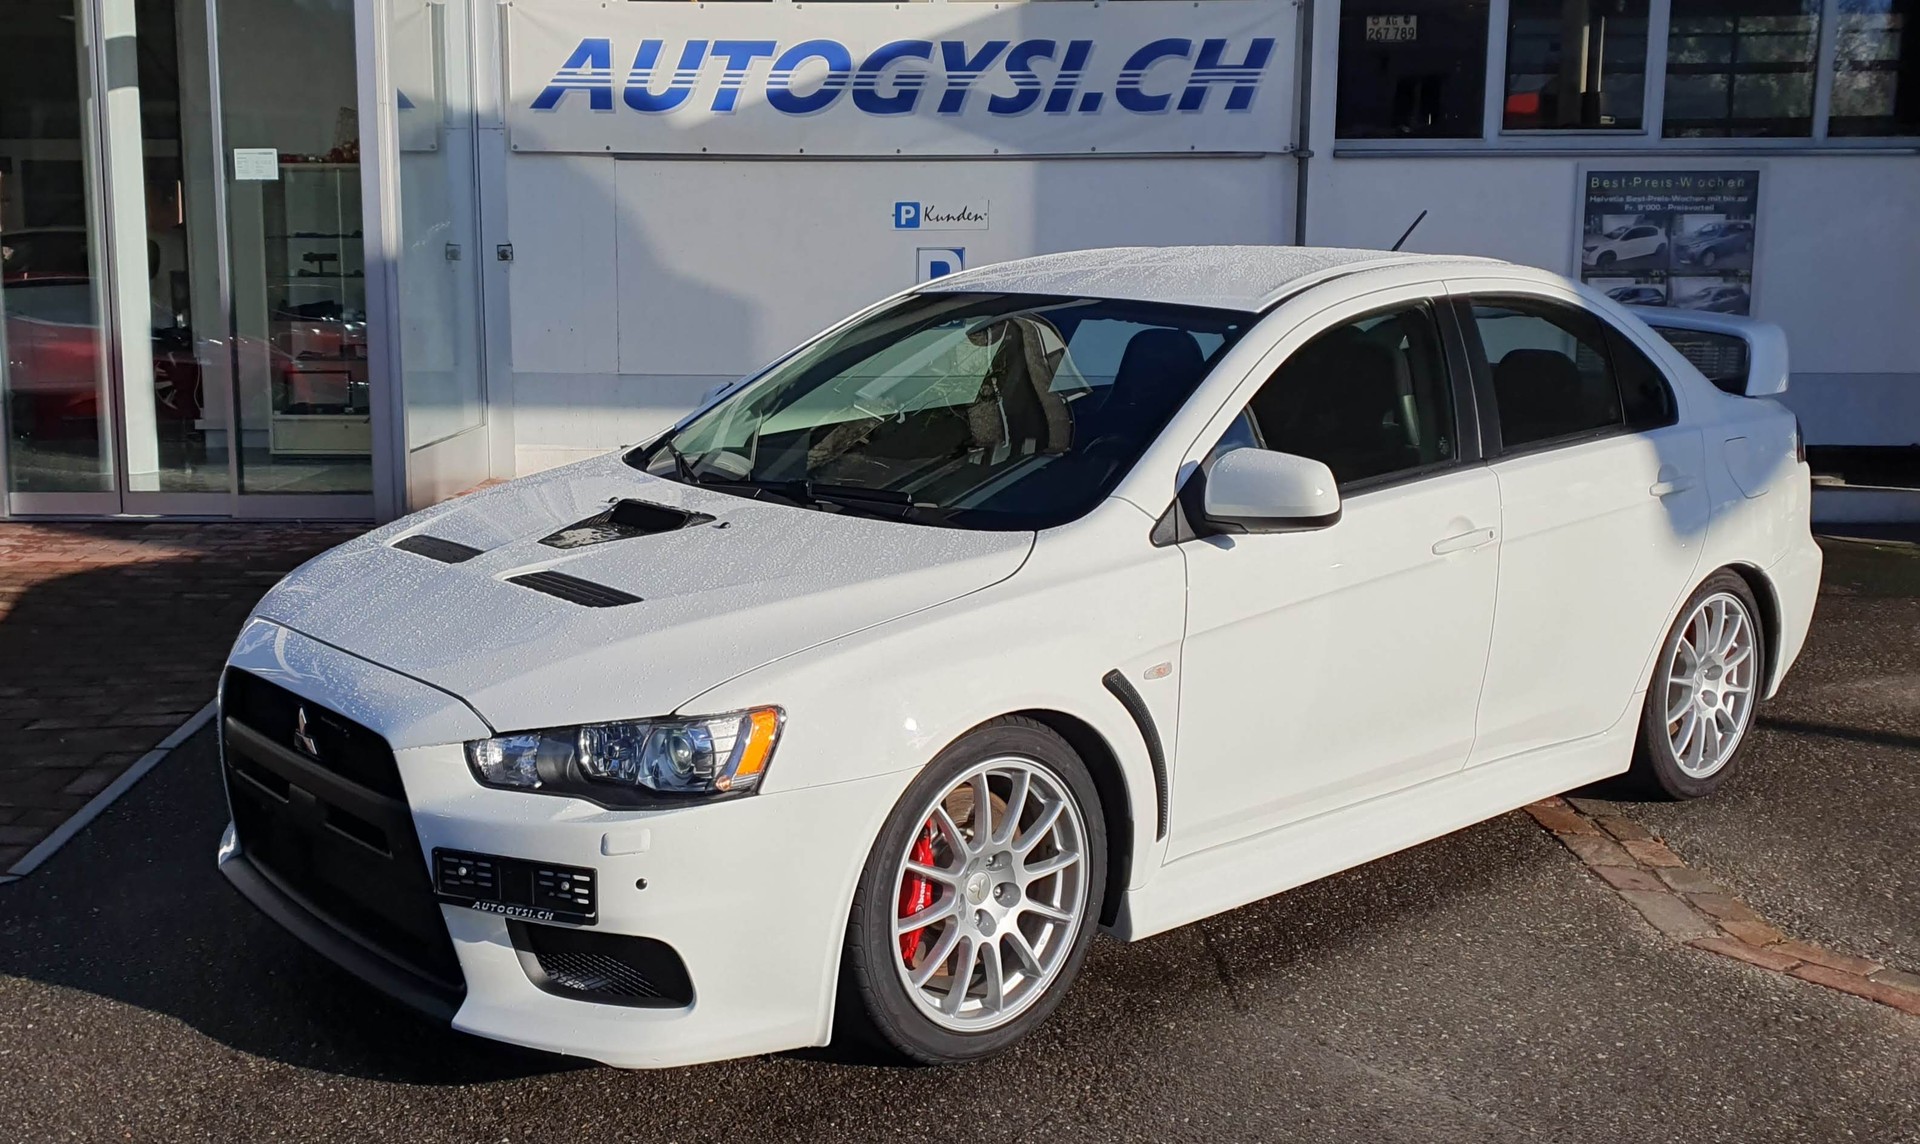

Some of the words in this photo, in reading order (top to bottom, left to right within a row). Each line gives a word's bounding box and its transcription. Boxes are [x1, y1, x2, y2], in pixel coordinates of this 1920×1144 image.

[1368, 28, 1390, 40] 267
[1393, 27, 1415, 40] 789
[530, 38, 1276, 114] AUTOGYSI.CH
[901, 205, 916, 225] P
[923, 205, 984, 222] Kunden
[472, 901, 554, 921] AUTOGYSI.CH
